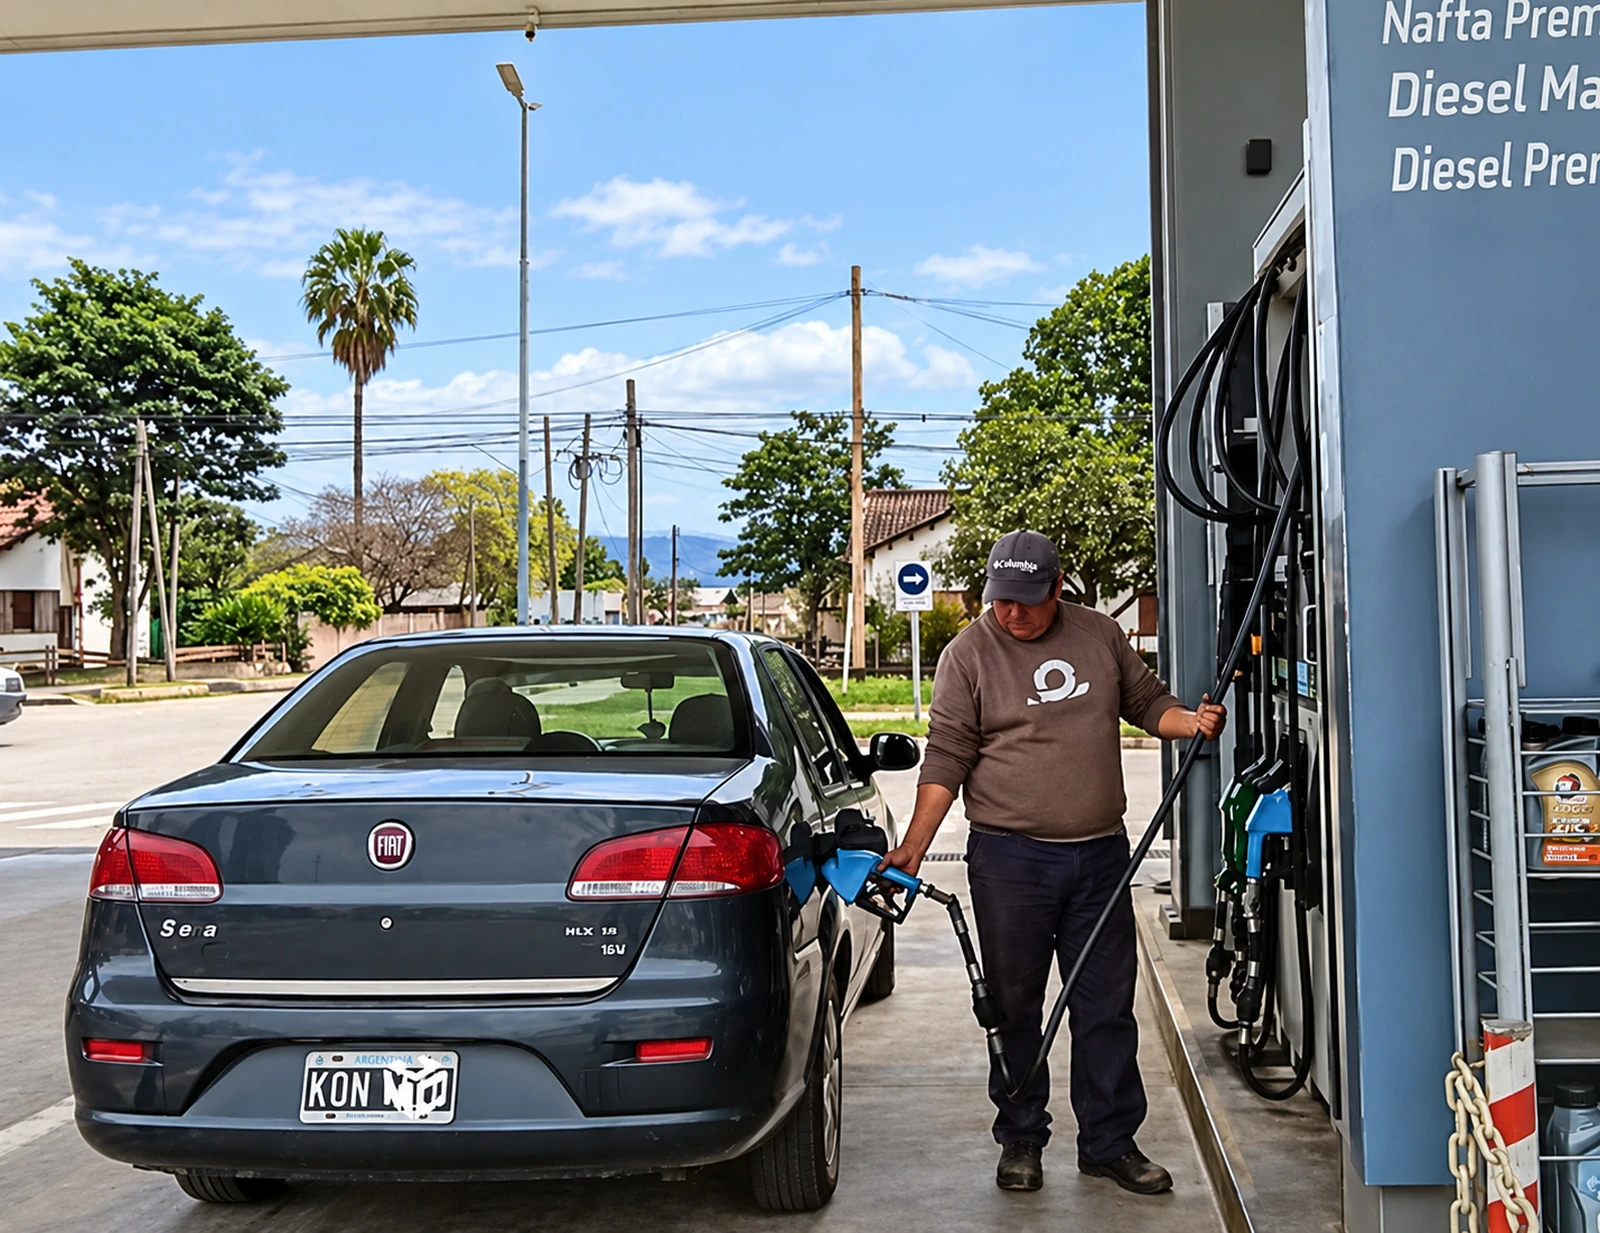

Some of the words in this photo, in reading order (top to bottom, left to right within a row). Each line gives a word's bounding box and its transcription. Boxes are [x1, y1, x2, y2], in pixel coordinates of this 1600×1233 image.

[1382, 0, 1493, 44] Nafta
[1388, 63, 1526, 117] Diesel
[1540, 65, 1600, 112] Ma
[1392, 141, 1512, 192] Diesel
[377, 835, 405, 857] FIAT
[565, 927, 594, 936] HLX
[601, 944, 626, 955] 16V
[308, 1071, 371, 1107] KON
